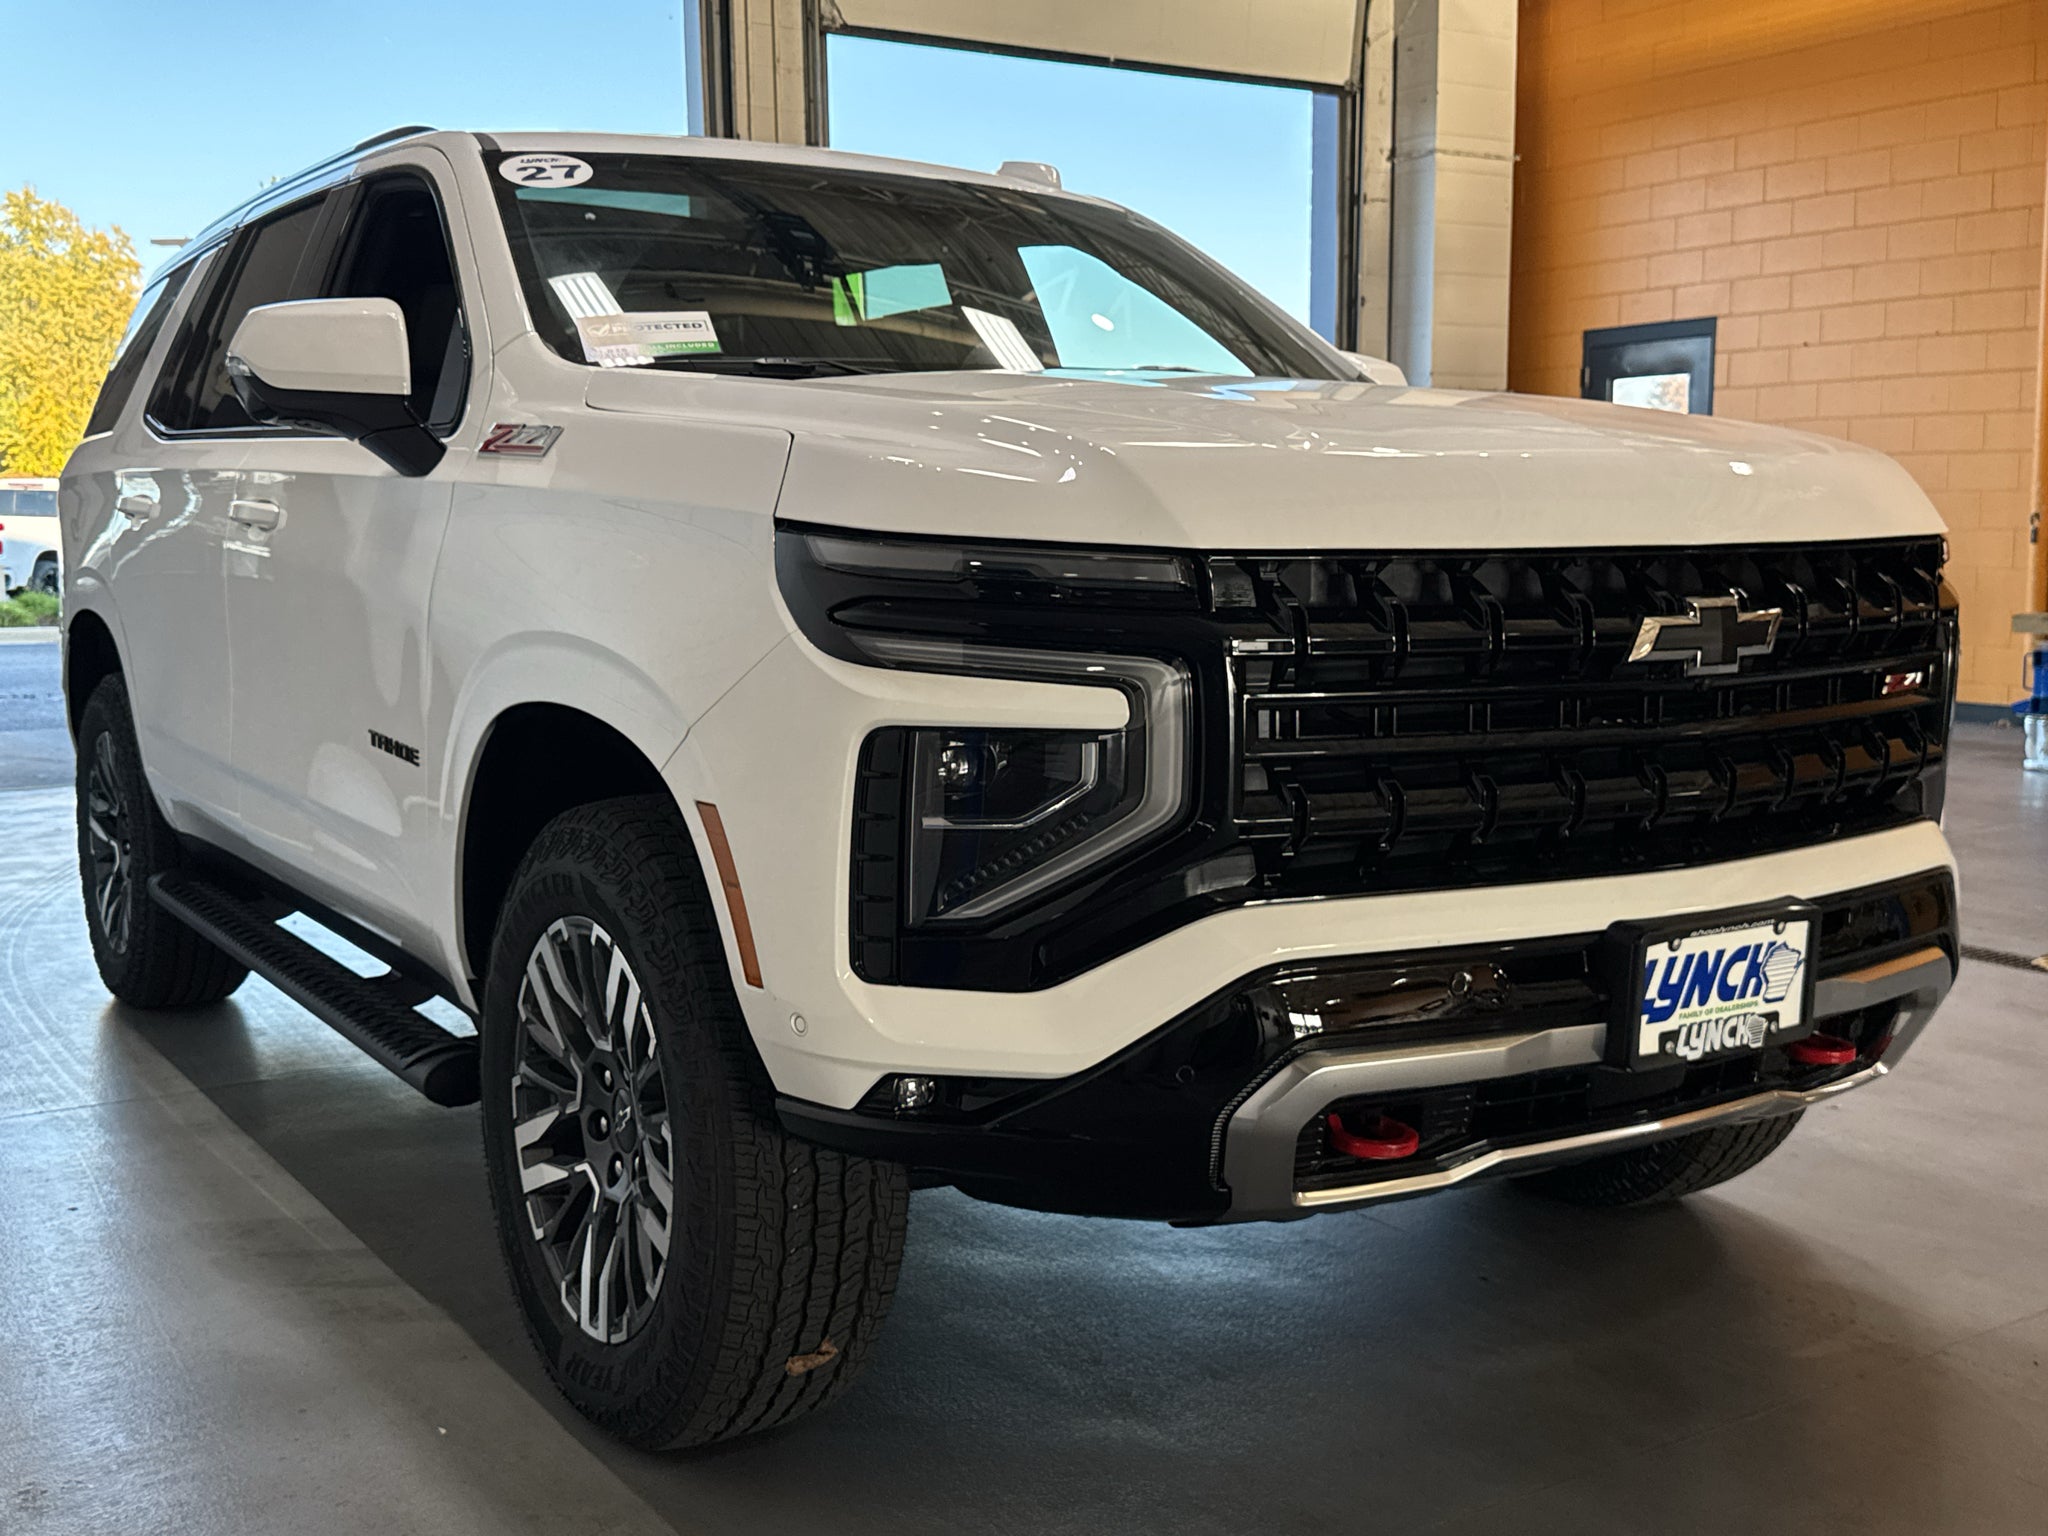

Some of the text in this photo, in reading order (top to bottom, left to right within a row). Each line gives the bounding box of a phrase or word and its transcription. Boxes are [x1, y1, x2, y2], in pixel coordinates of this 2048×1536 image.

[516, 164, 581, 182] 27
[665, 342, 715, 350] INCLUDED
[1881, 671, 1923, 694] Z71
[368, 728, 420, 767] TAHOE
[1641, 941, 1776, 1024] LYNCH
[1679, 1000, 1759, 1020] FAMILY OF DEALERSHIPS
[1675, 1013, 1750, 1061] LYNCH
